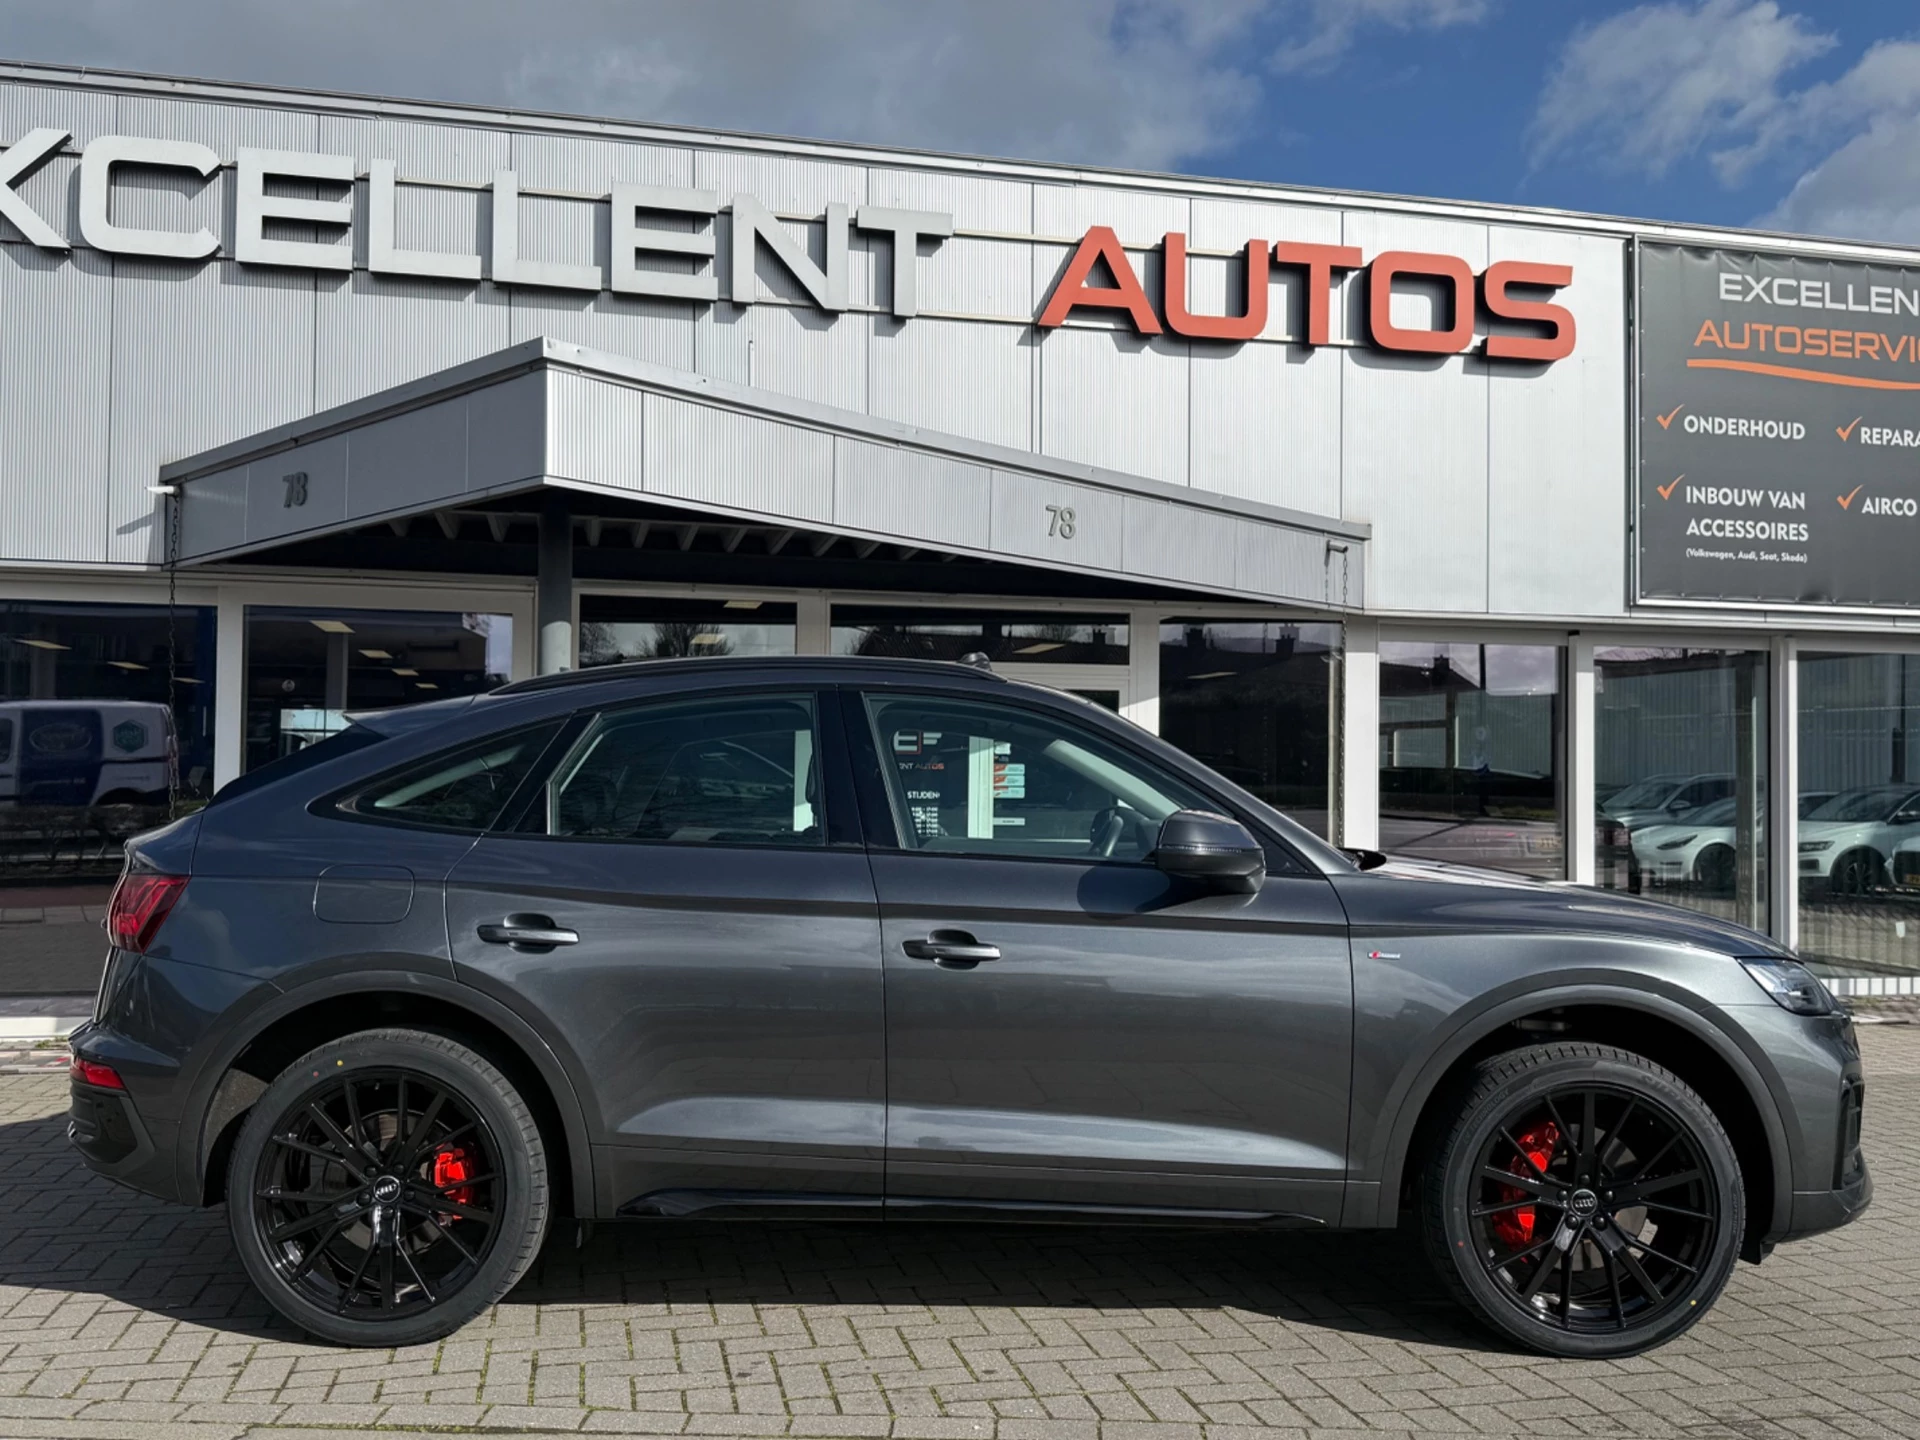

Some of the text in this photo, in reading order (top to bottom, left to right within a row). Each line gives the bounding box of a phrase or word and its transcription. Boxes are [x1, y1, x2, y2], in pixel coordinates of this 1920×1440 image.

[1038, 225, 1577, 361] AUTOS
[1693, 319, 1920, 363] AUTOSERVI
[1683, 414, 1806, 440] ONDERHOUD
[282, 471, 309, 509] 78
[1686, 485, 1806, 510] INBOUW VAN
[1045, 504, 1076, 540] 78
[1861, 496, 1918, 517] AIRCO
[1686, 518, 1809, 542] ACCESSOIRES
